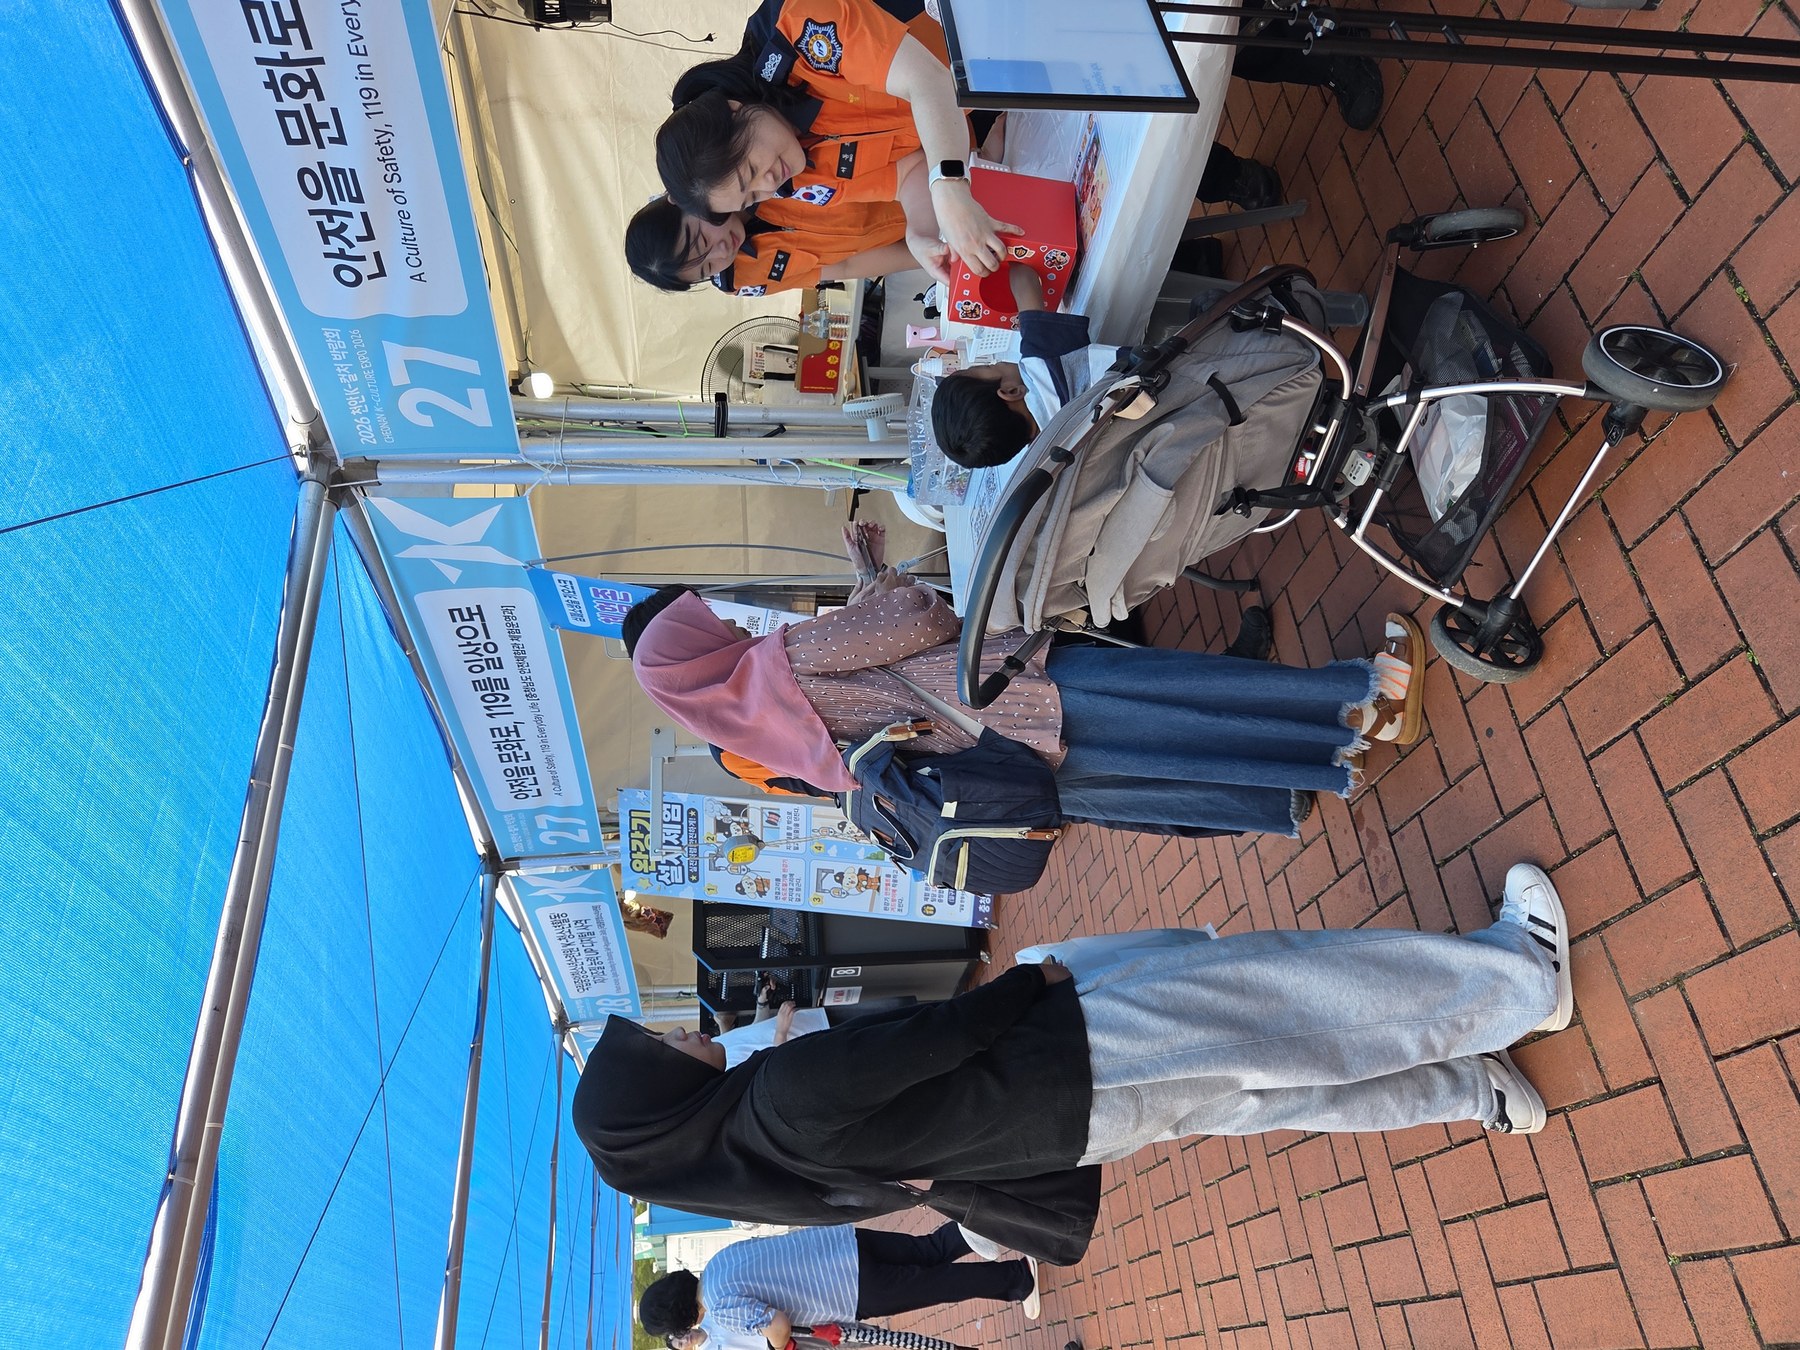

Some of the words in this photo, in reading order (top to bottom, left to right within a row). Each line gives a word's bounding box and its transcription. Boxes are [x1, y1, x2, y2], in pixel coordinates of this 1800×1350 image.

[815, 40, 824, 56] 119
[354, 63, 375, 81] in
[358, 86, 384, 120] 119
[373, 123, 402, 184] Safety,
[386, 188, 408, 205] of
[296, 160, 388, 289] 안전을
[397, 209, 422, 268] Culture
[409, 271, 427, 283] A
[321, 327, 349, 361] 박람회
[349, 329, 365, 348] 2026
[356, 350, 372, 368] EXPO
[363, 369, 383, 412] K-CULTURE
[382, 339, 493, 427] 27
[354, 416, 377, 445] 2026
[375, 413, 395, 444] CHEONAN
[500, 605, 522, 642] 체험운영과]
[447, 604, 504, 674] 일상으로
[511, 642, 531, 675] 안전체험관
[466, 676, 515, 719] 119를
[522, 675, 540, 702] [충청남도
[529, 702, 542, 713] Life
[533, 713, 548, 739] Everyday
[489, 721, 531, 764] 문화로,
[540, 744, 551, 753] 119
[544, 753, 558, 770] Safety,
[502, 765, 542, 800] 안전을
[549, 775, 562, 792] Culture
[534, 814, 590, 845] 27
[630, 811, 656, 873] 완강기
[978, 894, 991, 913] 충청
[576, 931, 598, 947] 디지털
[583, 948, 599, 956] UP
[595, 998, 633, 1015] 28
